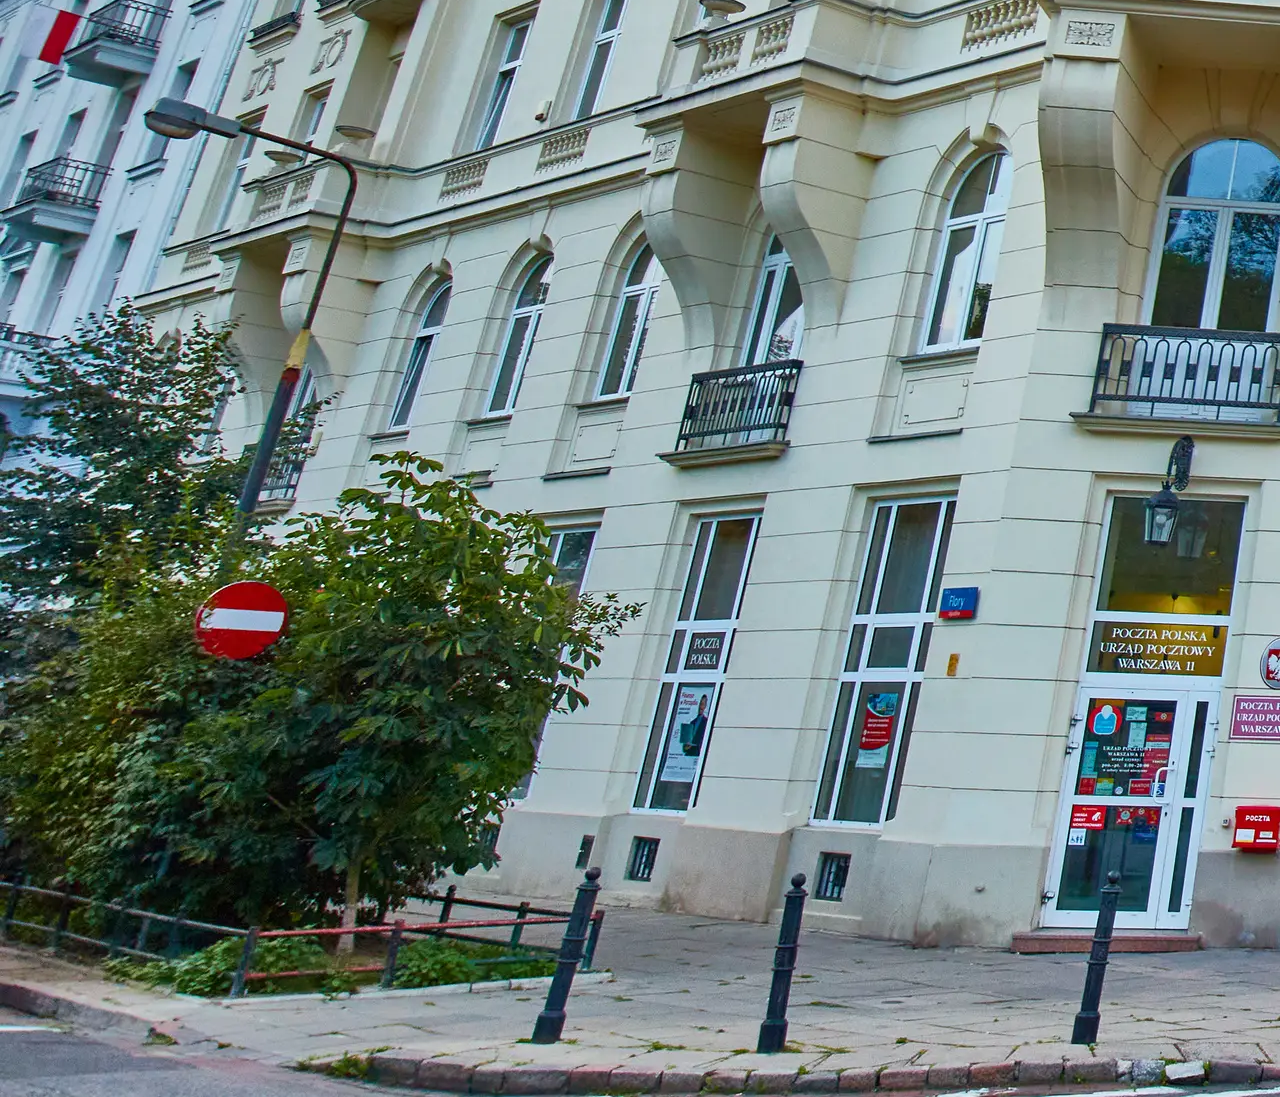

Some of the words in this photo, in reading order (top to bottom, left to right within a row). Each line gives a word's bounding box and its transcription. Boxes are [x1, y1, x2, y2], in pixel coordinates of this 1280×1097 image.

[948, 595, 965, 610] Flory
[1112, 627, 1158, 640] POCZTA
[1161, 629, 1207, 642] POLSKA
[693, 637, 720, 649] POCZTA
[1100, 642, 1144, 656] URZĄD
[1146, 644, 1216, 657] POCZTOWY
[689, 653, 717, 665] POLSKA
[1118, 658, 1181, 671] WARSZAWA
[1185, 661, 1195, 671] 11
[1240, 702, 1273, 710] POCZTA
[1236, 713, 1265, 723] URZĄD
[1245, 814, 1271, 822] POCZTA
